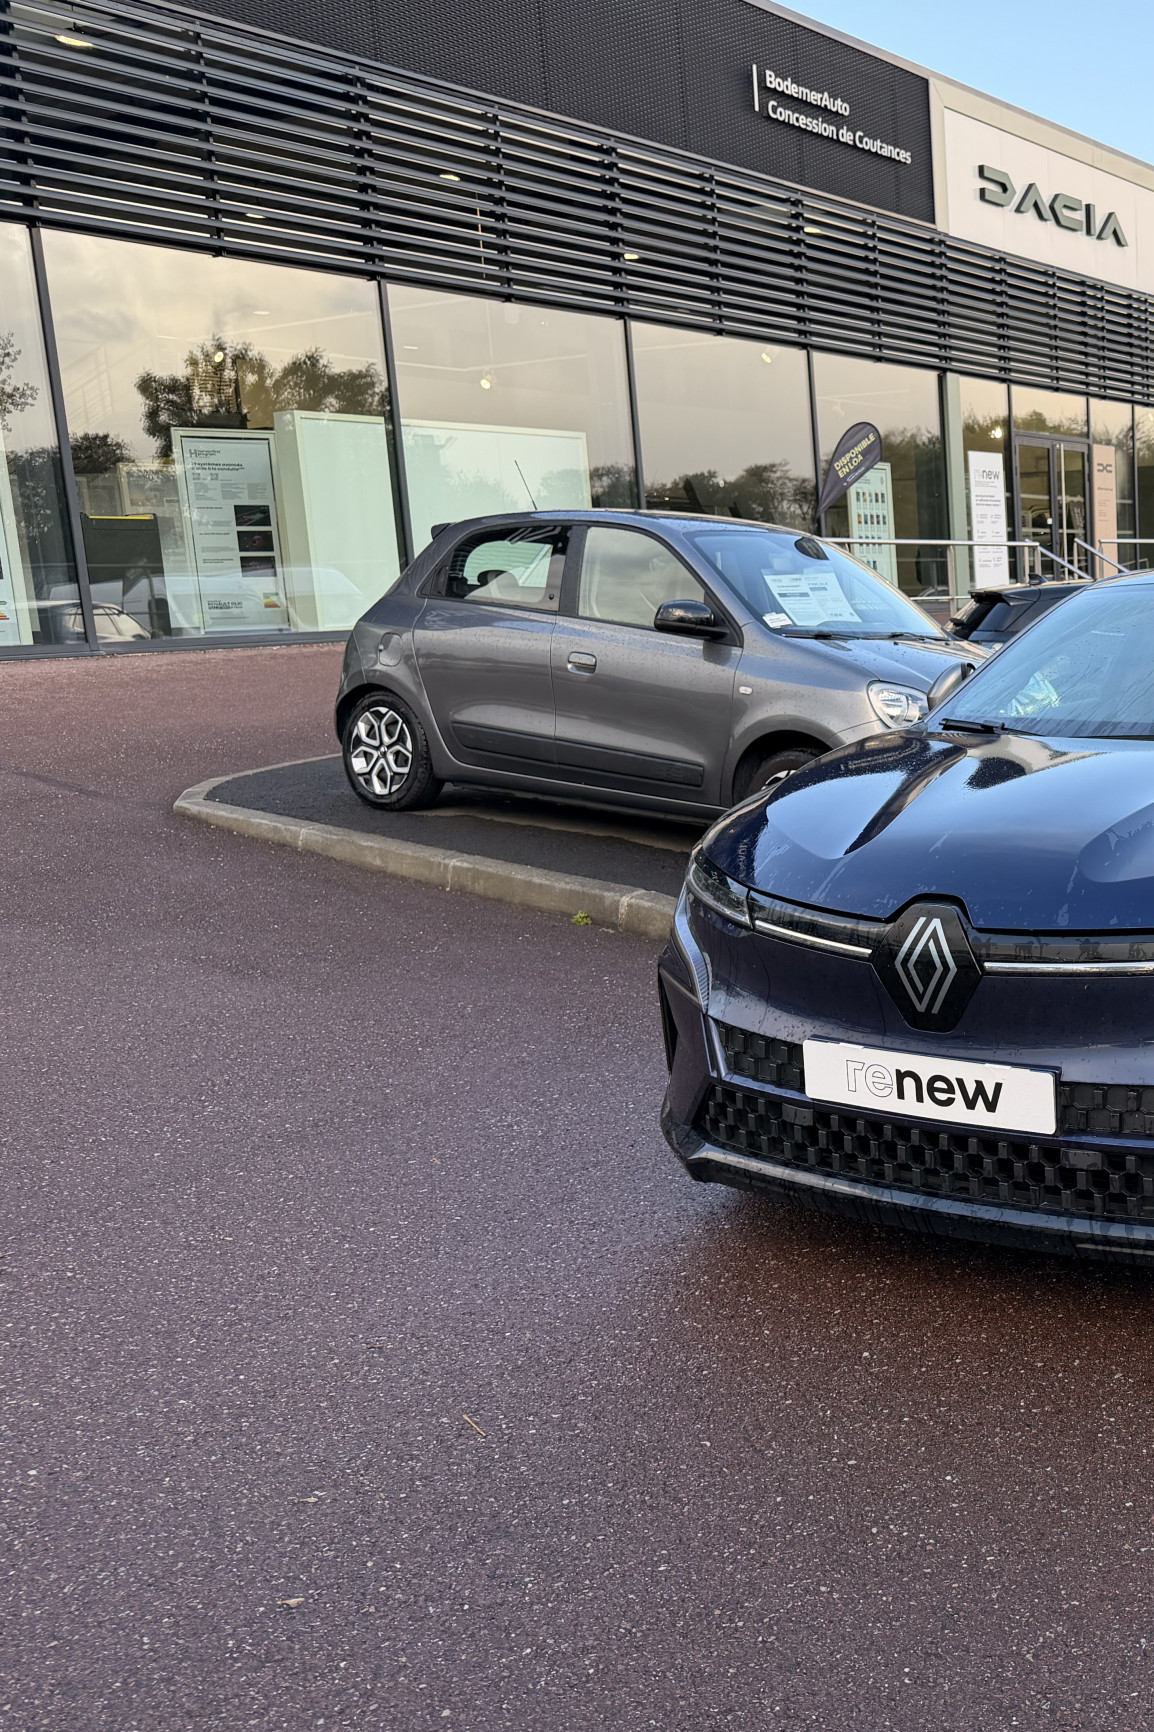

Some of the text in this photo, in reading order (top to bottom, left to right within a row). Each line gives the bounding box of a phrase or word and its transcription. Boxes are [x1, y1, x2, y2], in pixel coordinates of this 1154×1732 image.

[765, 69, 850, 116] BodemerAuto
[767, 100, 912, 165] Concession de Coutances
[978, 164, 1128, 247] DACIA
[834, 433, 875, 471] DISPONIBLE
[838, 466, 849, 478] EN
[848, 454, 863, 469] LOA
[845, 1059, 1003, 1113] renew
